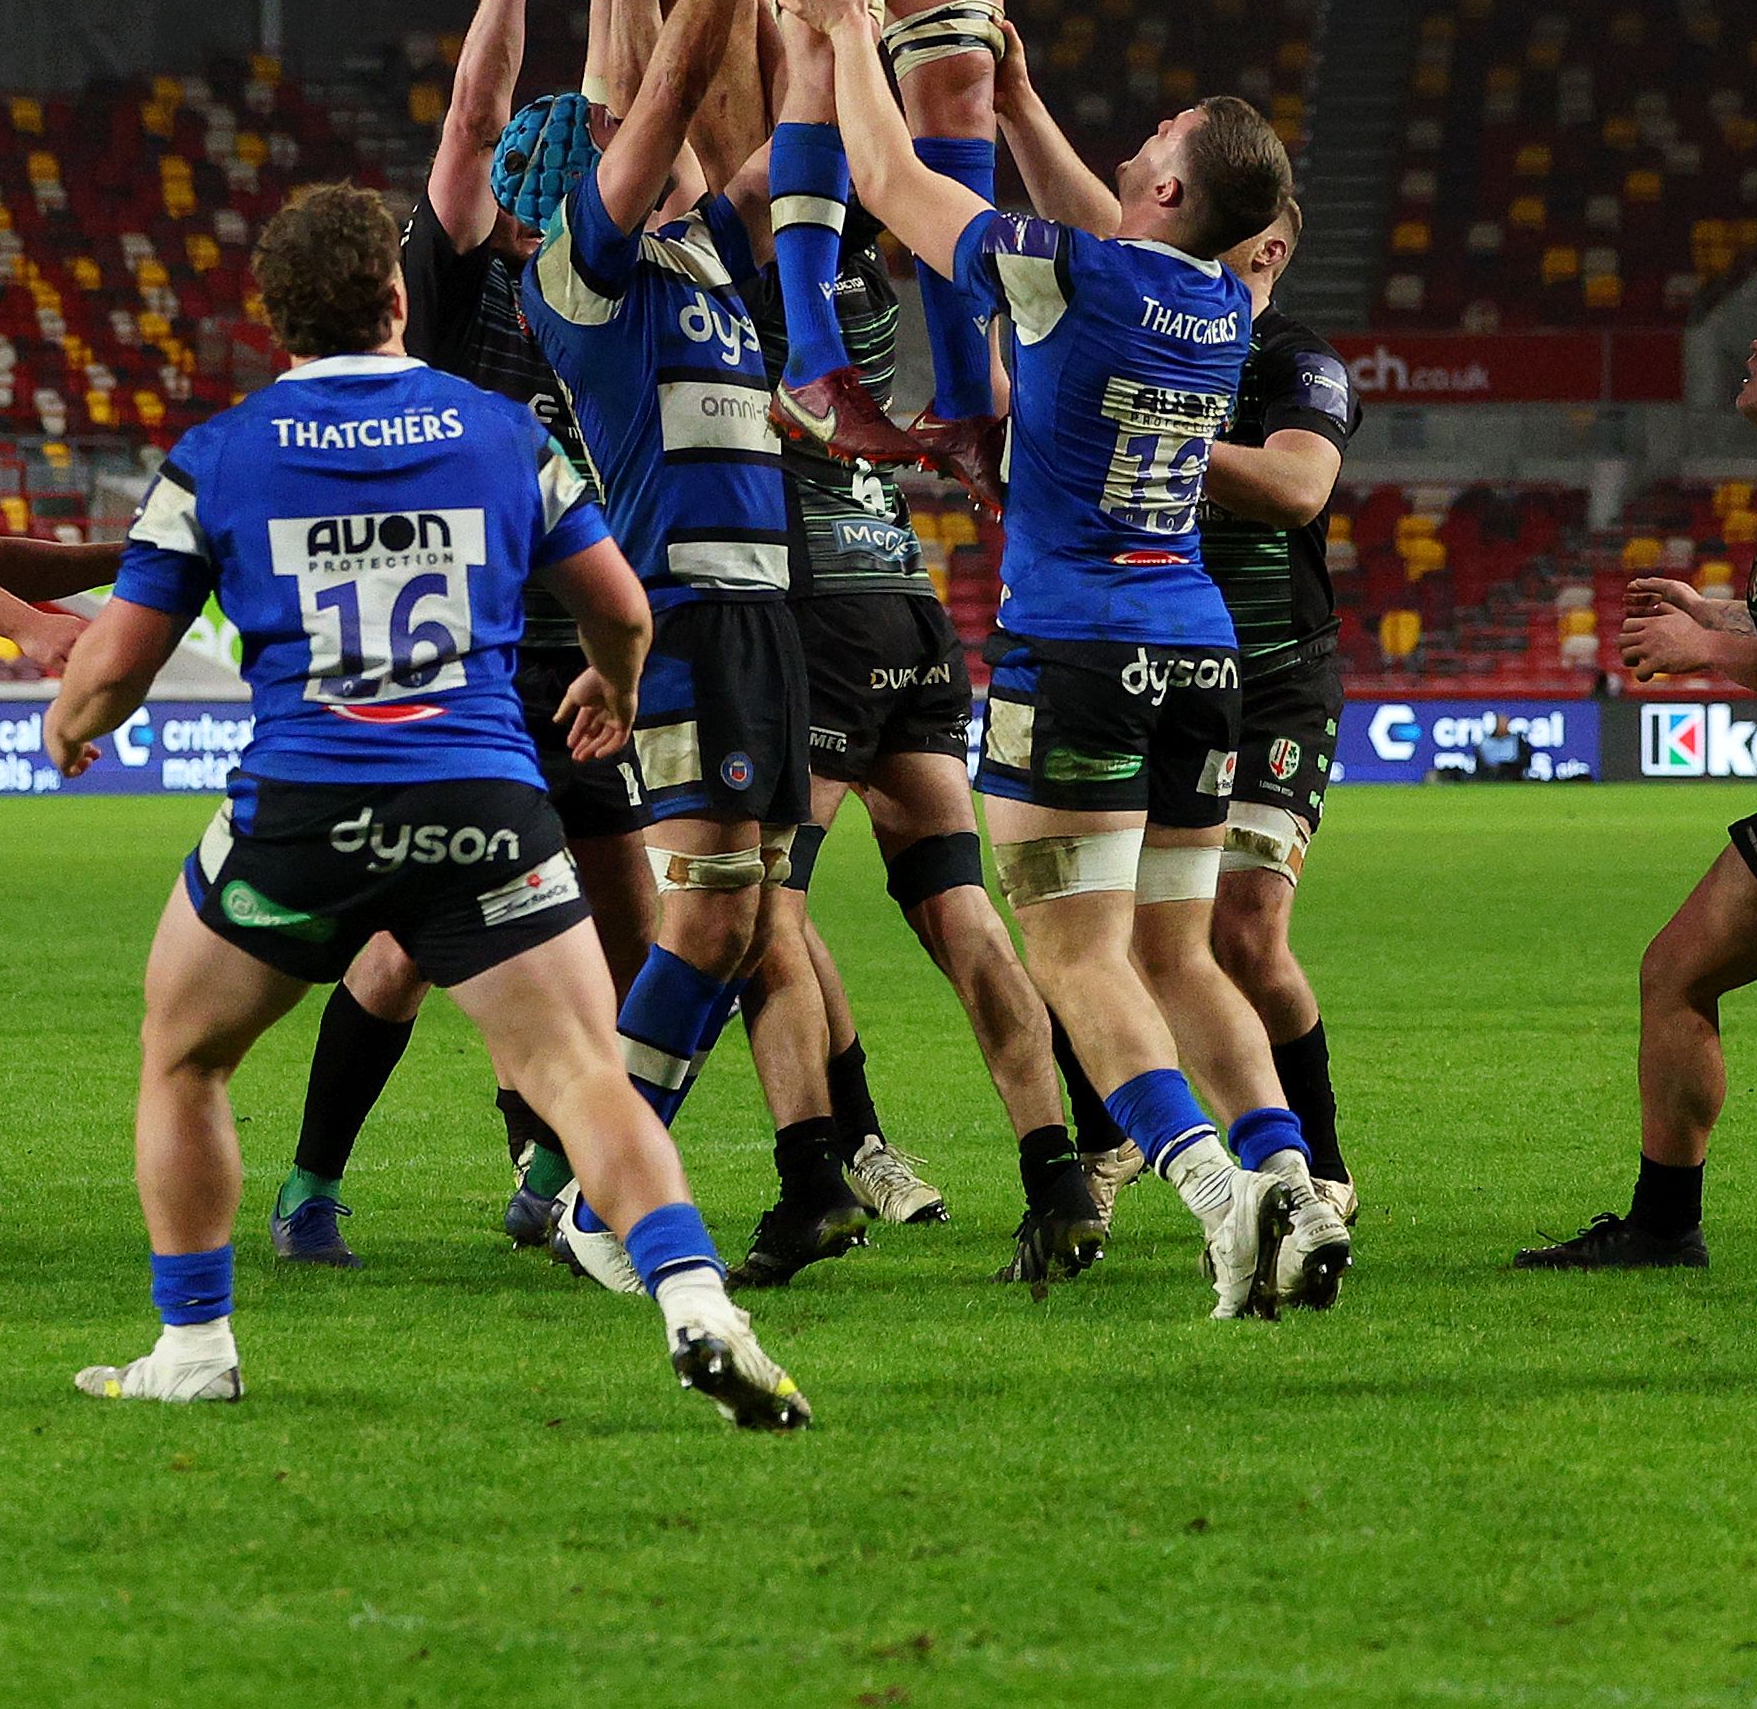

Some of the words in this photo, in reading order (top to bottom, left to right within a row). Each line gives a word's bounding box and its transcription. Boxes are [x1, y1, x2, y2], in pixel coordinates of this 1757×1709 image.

[679, 292, 761, 366] dys
[1141, 296, 1238, 344] THATCHERS
[271, 408, 464, 450] THATCHERS
[308, 554, 454, 573] PROTECTION
[316, 572, 458, 699] 16
[1122, 647, 1239, 706] dyson
[330, 807, 521, 874] dyson
